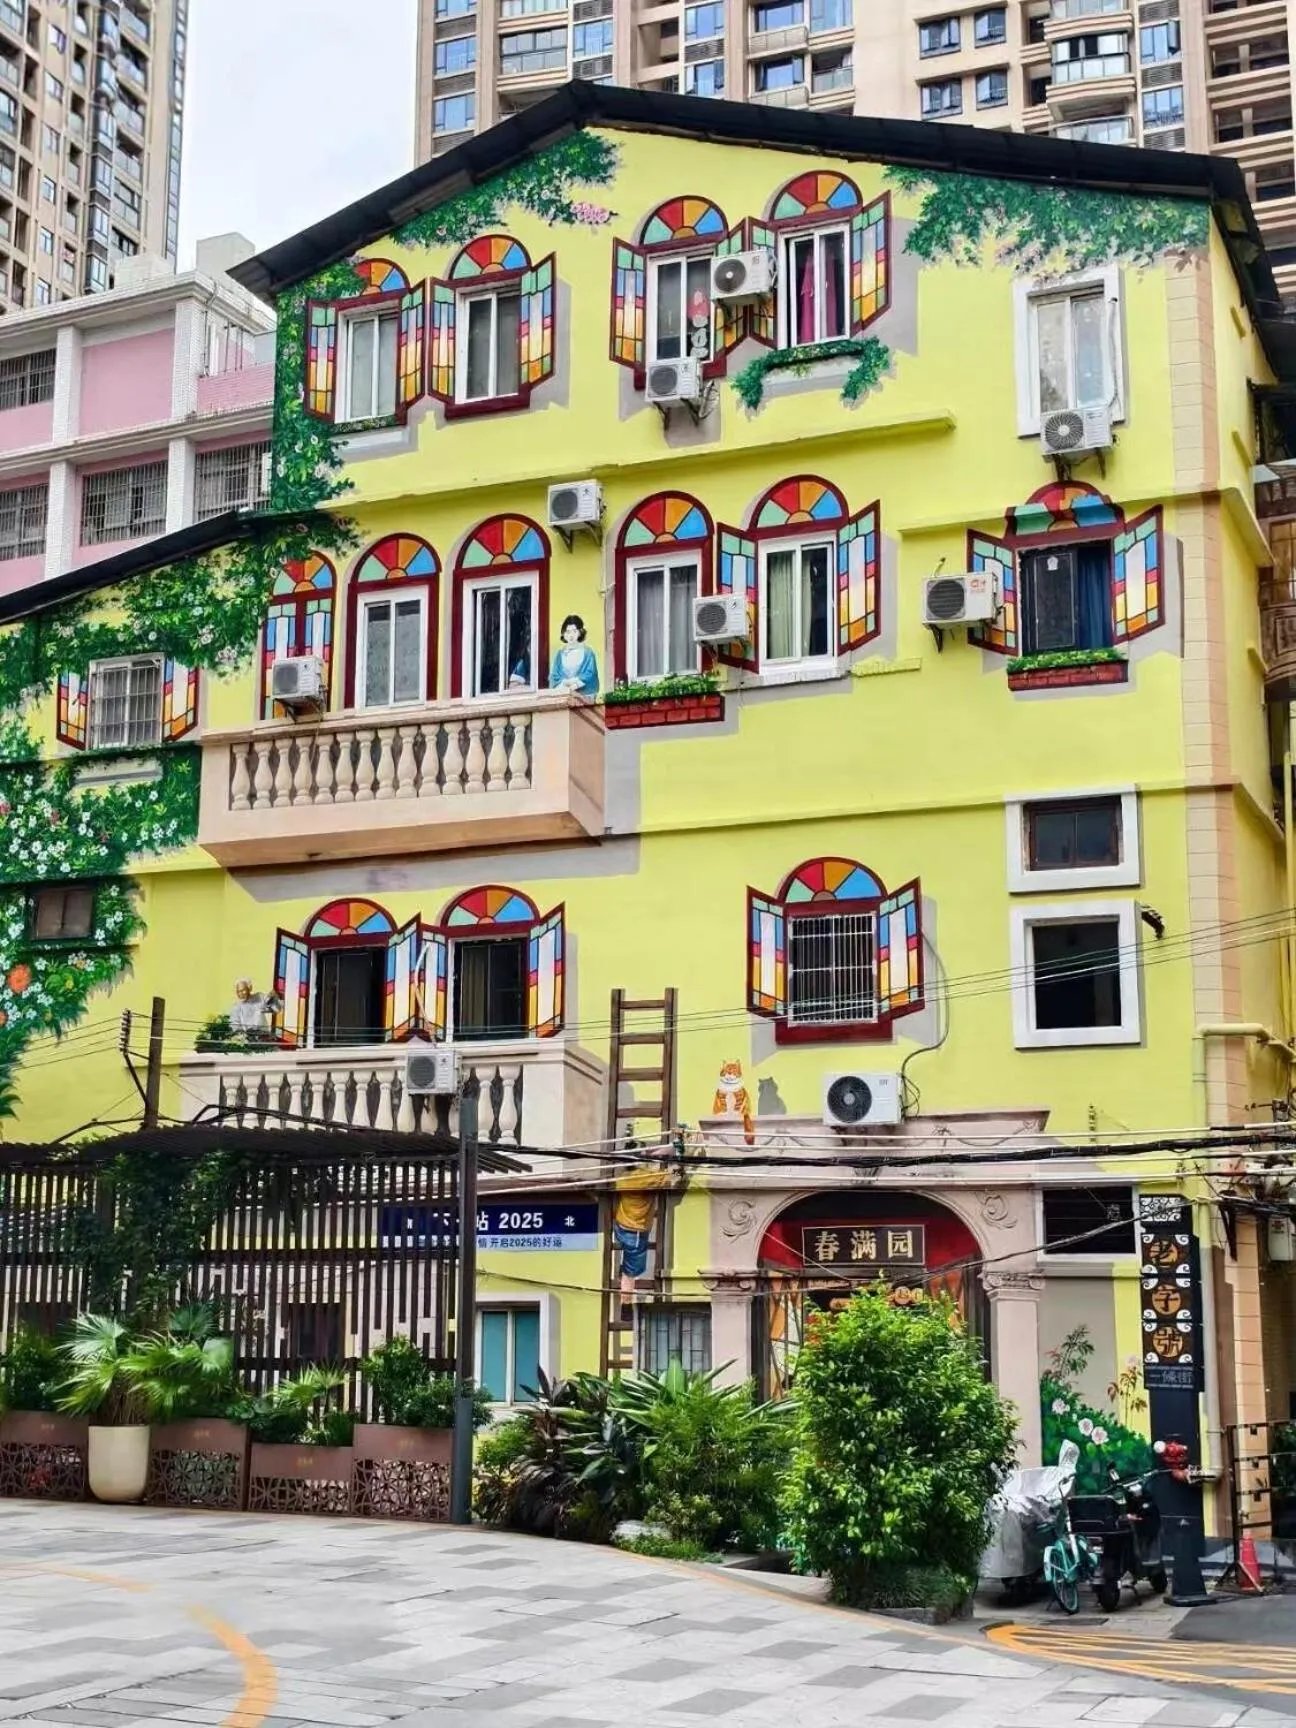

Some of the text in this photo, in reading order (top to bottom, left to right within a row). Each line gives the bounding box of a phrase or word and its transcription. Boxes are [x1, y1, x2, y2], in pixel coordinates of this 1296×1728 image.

[498, 1212, 544, 1229] 2025
[564, 1215, 575, 1227] 北
[814, 1229, 914, 1261] 春满园
